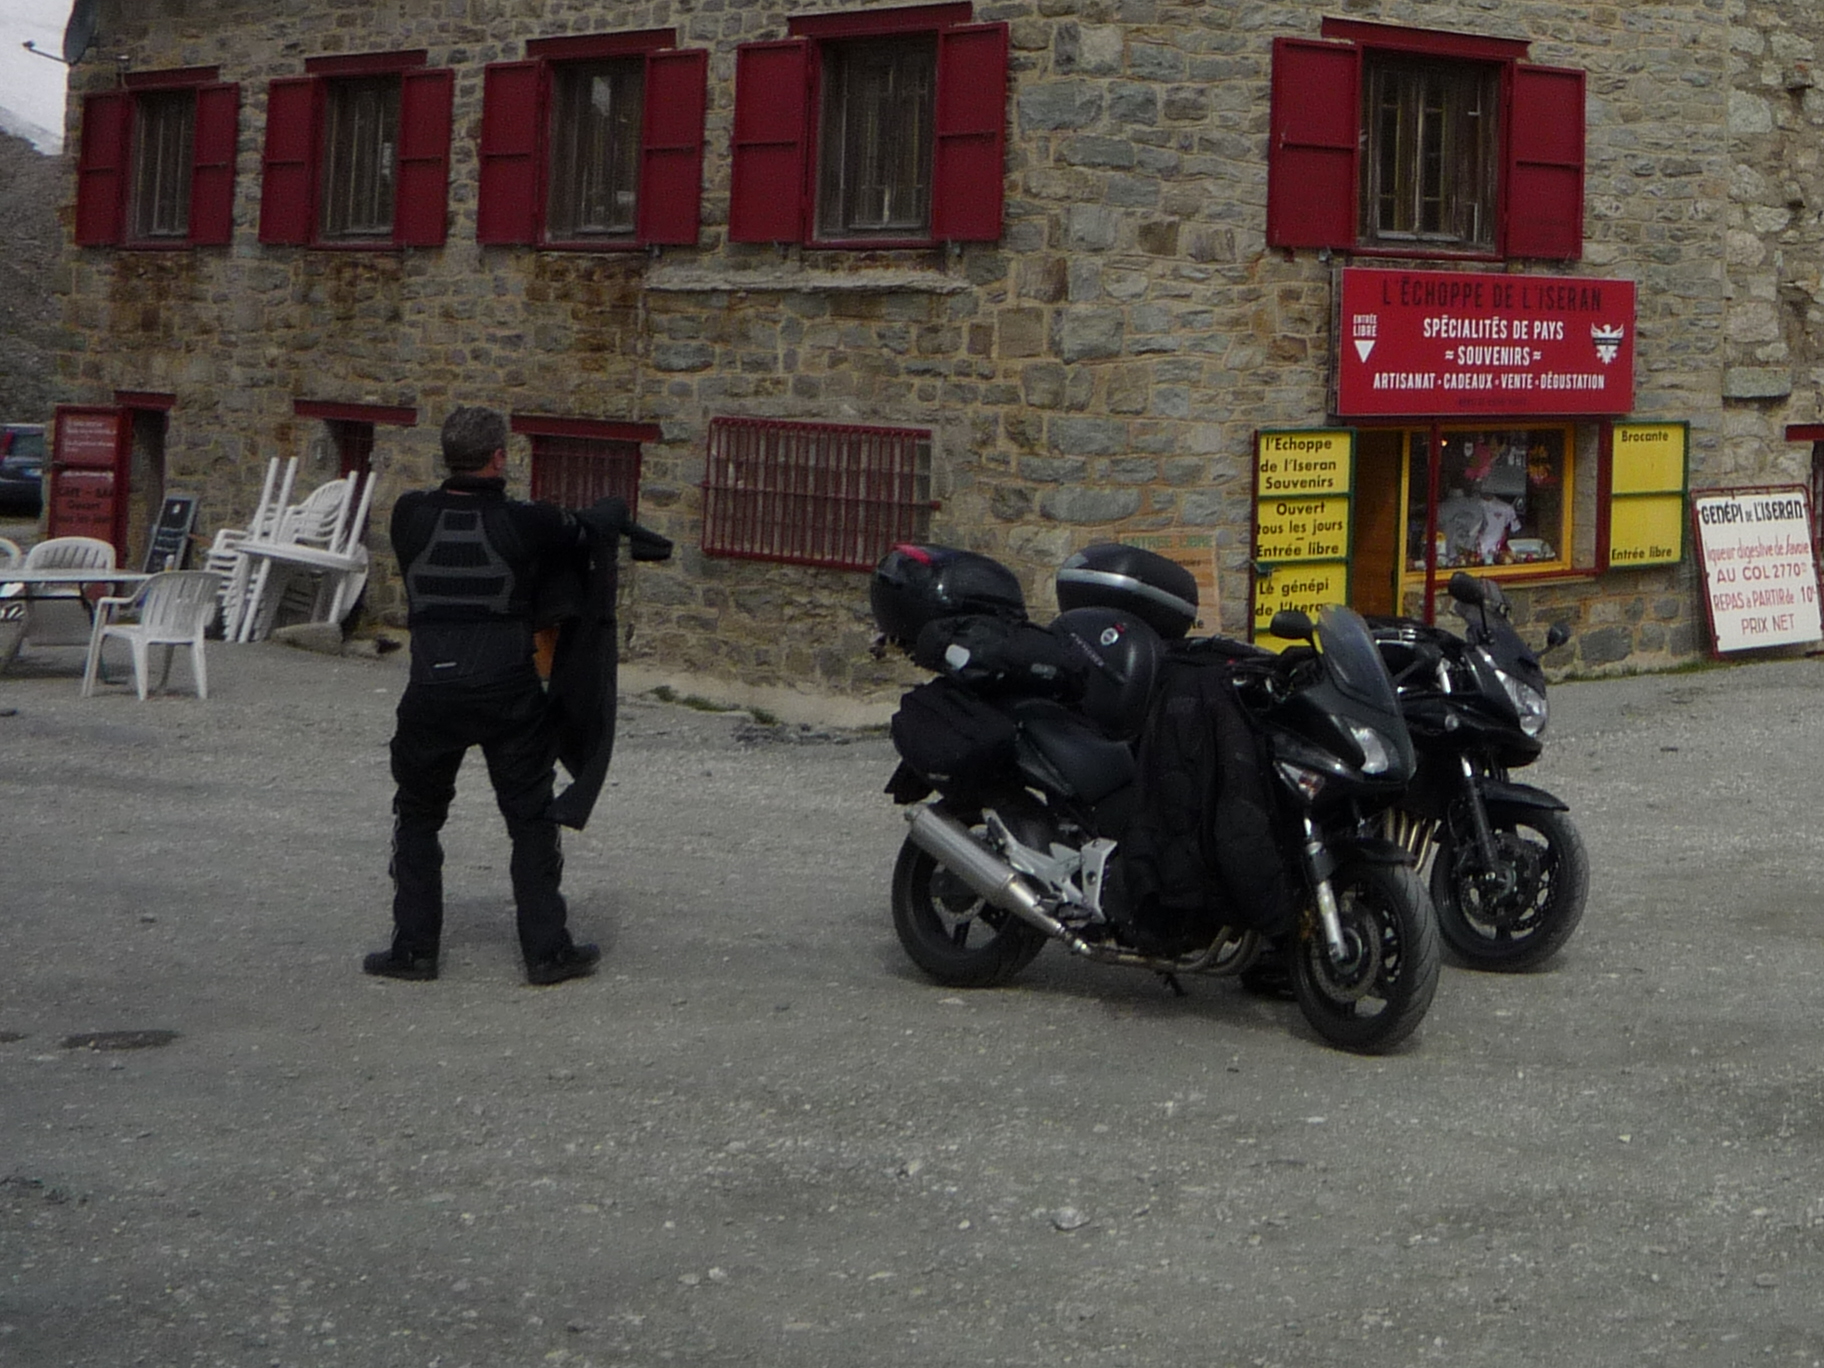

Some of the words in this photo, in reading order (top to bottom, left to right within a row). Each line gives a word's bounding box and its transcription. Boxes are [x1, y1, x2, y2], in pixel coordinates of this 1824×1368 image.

[1382, 276, 1483, 308] L'ÉCHOPPE
[1492, 283, 1514, 309] DE
[1522, 283, 1602, 311] L'ISERAN
[1352, 314, 1378, 325] ENTRÉE
[1423, 315, 1508, 340] SPÉCIALITÉS
[1512, 321, 1529, 340] DE
[1533, 321, 1564, 341] PAYS
[1352, 325, 1377, 337] LIBRE
[1457, 346, 1531, 366] SOUVENIRS
[1373, 373, 1435, 390] ARTISANAT
[1443, 373, 1493, 390] CADEAUX
[1501, 374, 1533, 390] VENTE
[1540, 371, 1605, 390] DÉGUSTATION
[1621, 430, 1669, 442] Brocante
[1265, 437, 1332, 454] l'Echoppe
[1260, 461, 1277, 473] de
[1284, 458, 1336, 472] l'Iseran
[1265, 475, 1334, 490] Souvenirs
[1276, 502, 1326, 516] Ouvert
[1701, 501, 1744, 525] GENÉPI
[1753, 499, 1803, 522] L'ISERAN
[1257, 523, 1283, 535] tous
[1289, 521, 1307, 534] les
[1312, 520, 1343, 536] jours
[1256, 543, 1302, 558] Entrée
[1308, 542, 1339, 555] libre
[1611, 547, 1645, 561] Entrée
[1649, 546, 1672, 558] libre
[1774, 534, 1784, 557] de
[1717, 567, 1736, 584] AU
[1742, 563, 1771, 581] COL
[1259, 582, 1274, 595] Le
[1281, 578, 1329, 597] génépi
[1713, 591, 1745, 612] REPAS
[1752, 588, 1784, 608] PARTIR
[1785, 587, 1794, 605] de
[1255, 603, 1273, 617] de
[1741, 616, 1769, 635] PRIX
[1772, 613, 1795, 632] NET
